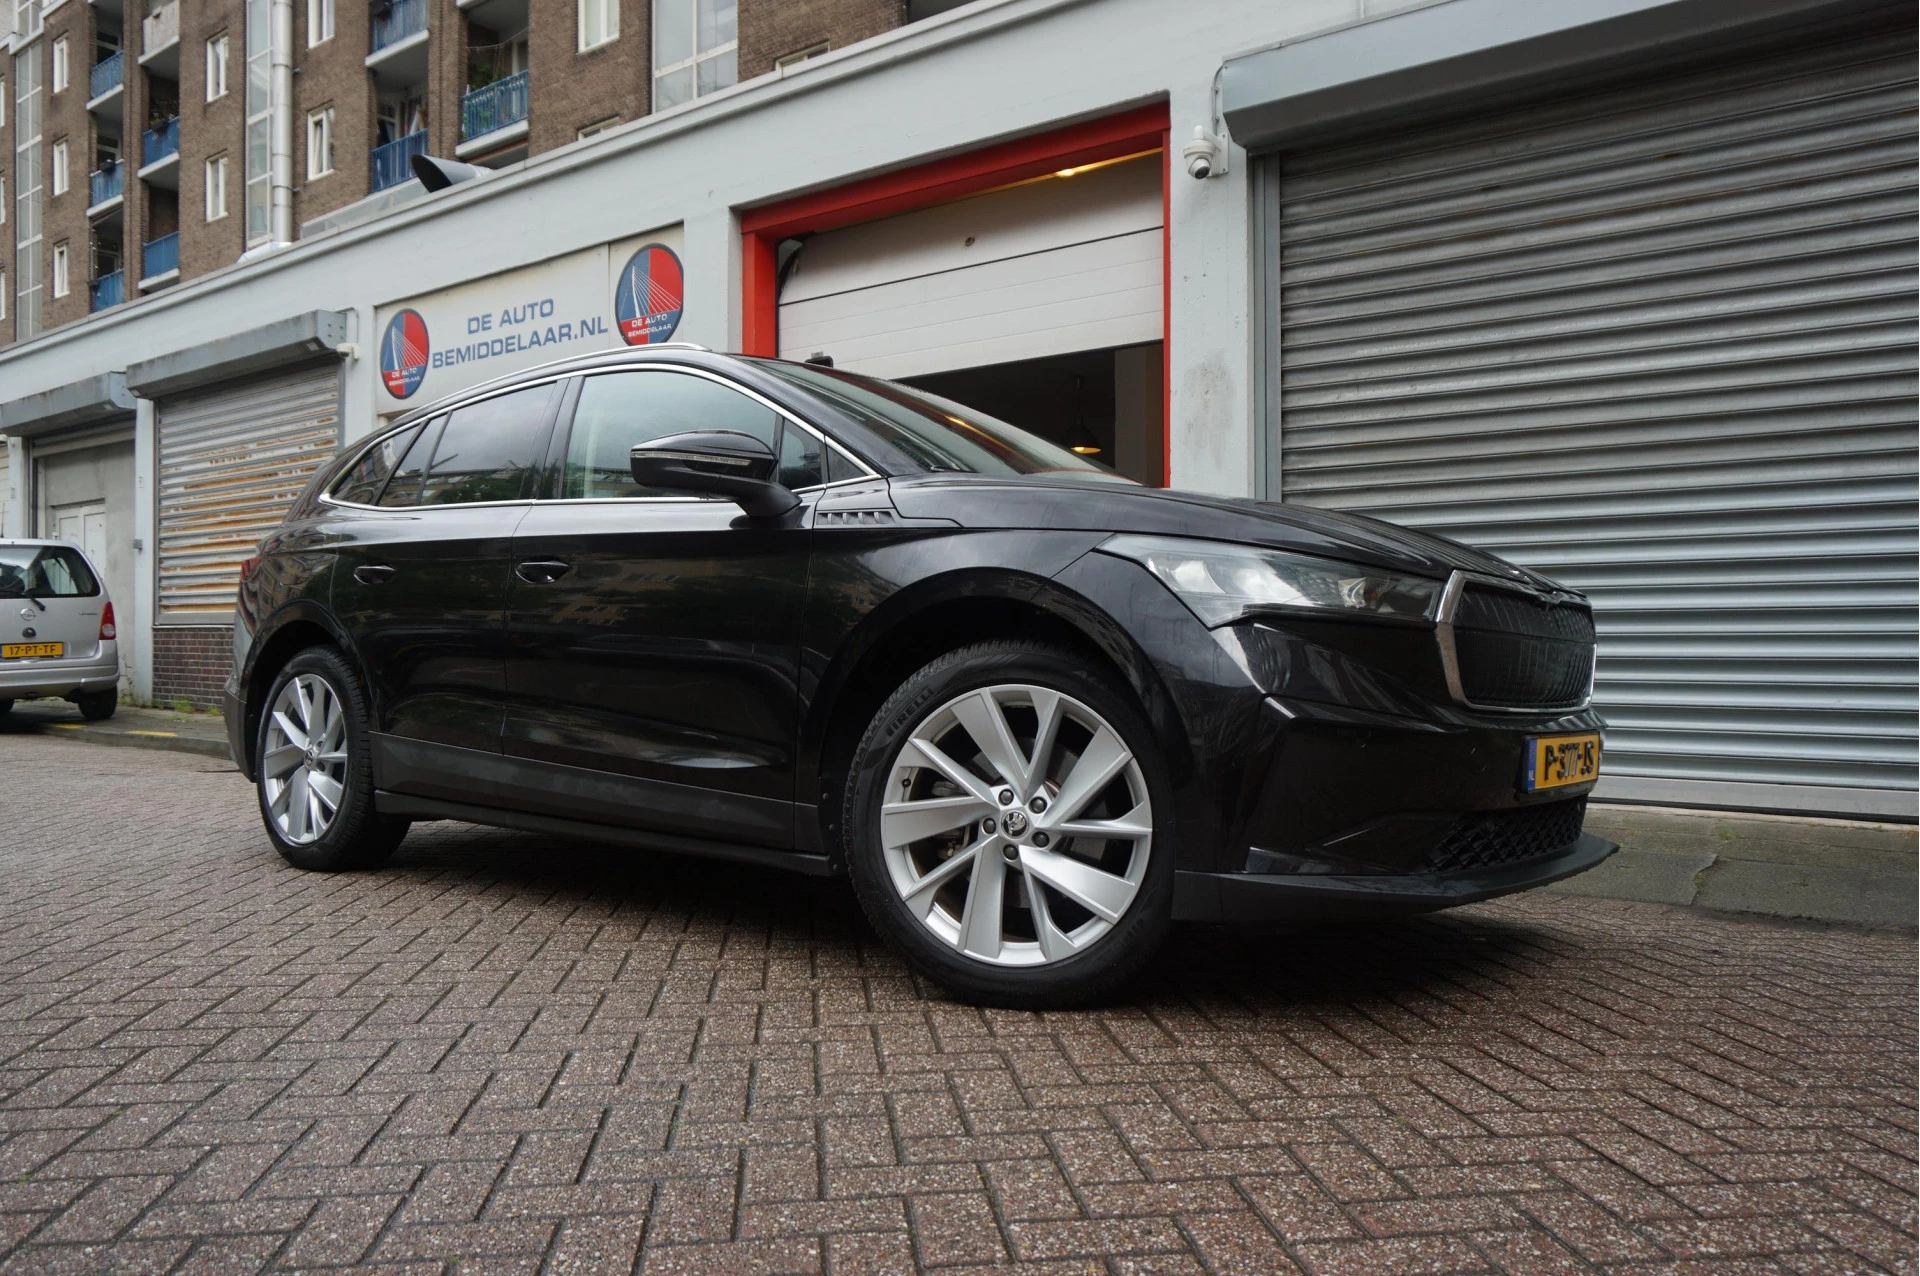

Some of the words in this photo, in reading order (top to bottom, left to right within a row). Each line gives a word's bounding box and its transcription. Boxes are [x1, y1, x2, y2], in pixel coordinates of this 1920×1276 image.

[467, 313, 492, 335] DE
[499, 298, 554, 328] AUTO
[631, 318, 643, 328] DE
[645, 313, 668, 325] AUTO
[432, 316, 608, 369] BEMIDDELAAR.NL
[628, 323, 672, 337] BEMIDDELAAR
[10, 644, 56, 656] 17-PT-TF
[1545, 741, 1594, 781] P-377-JS
